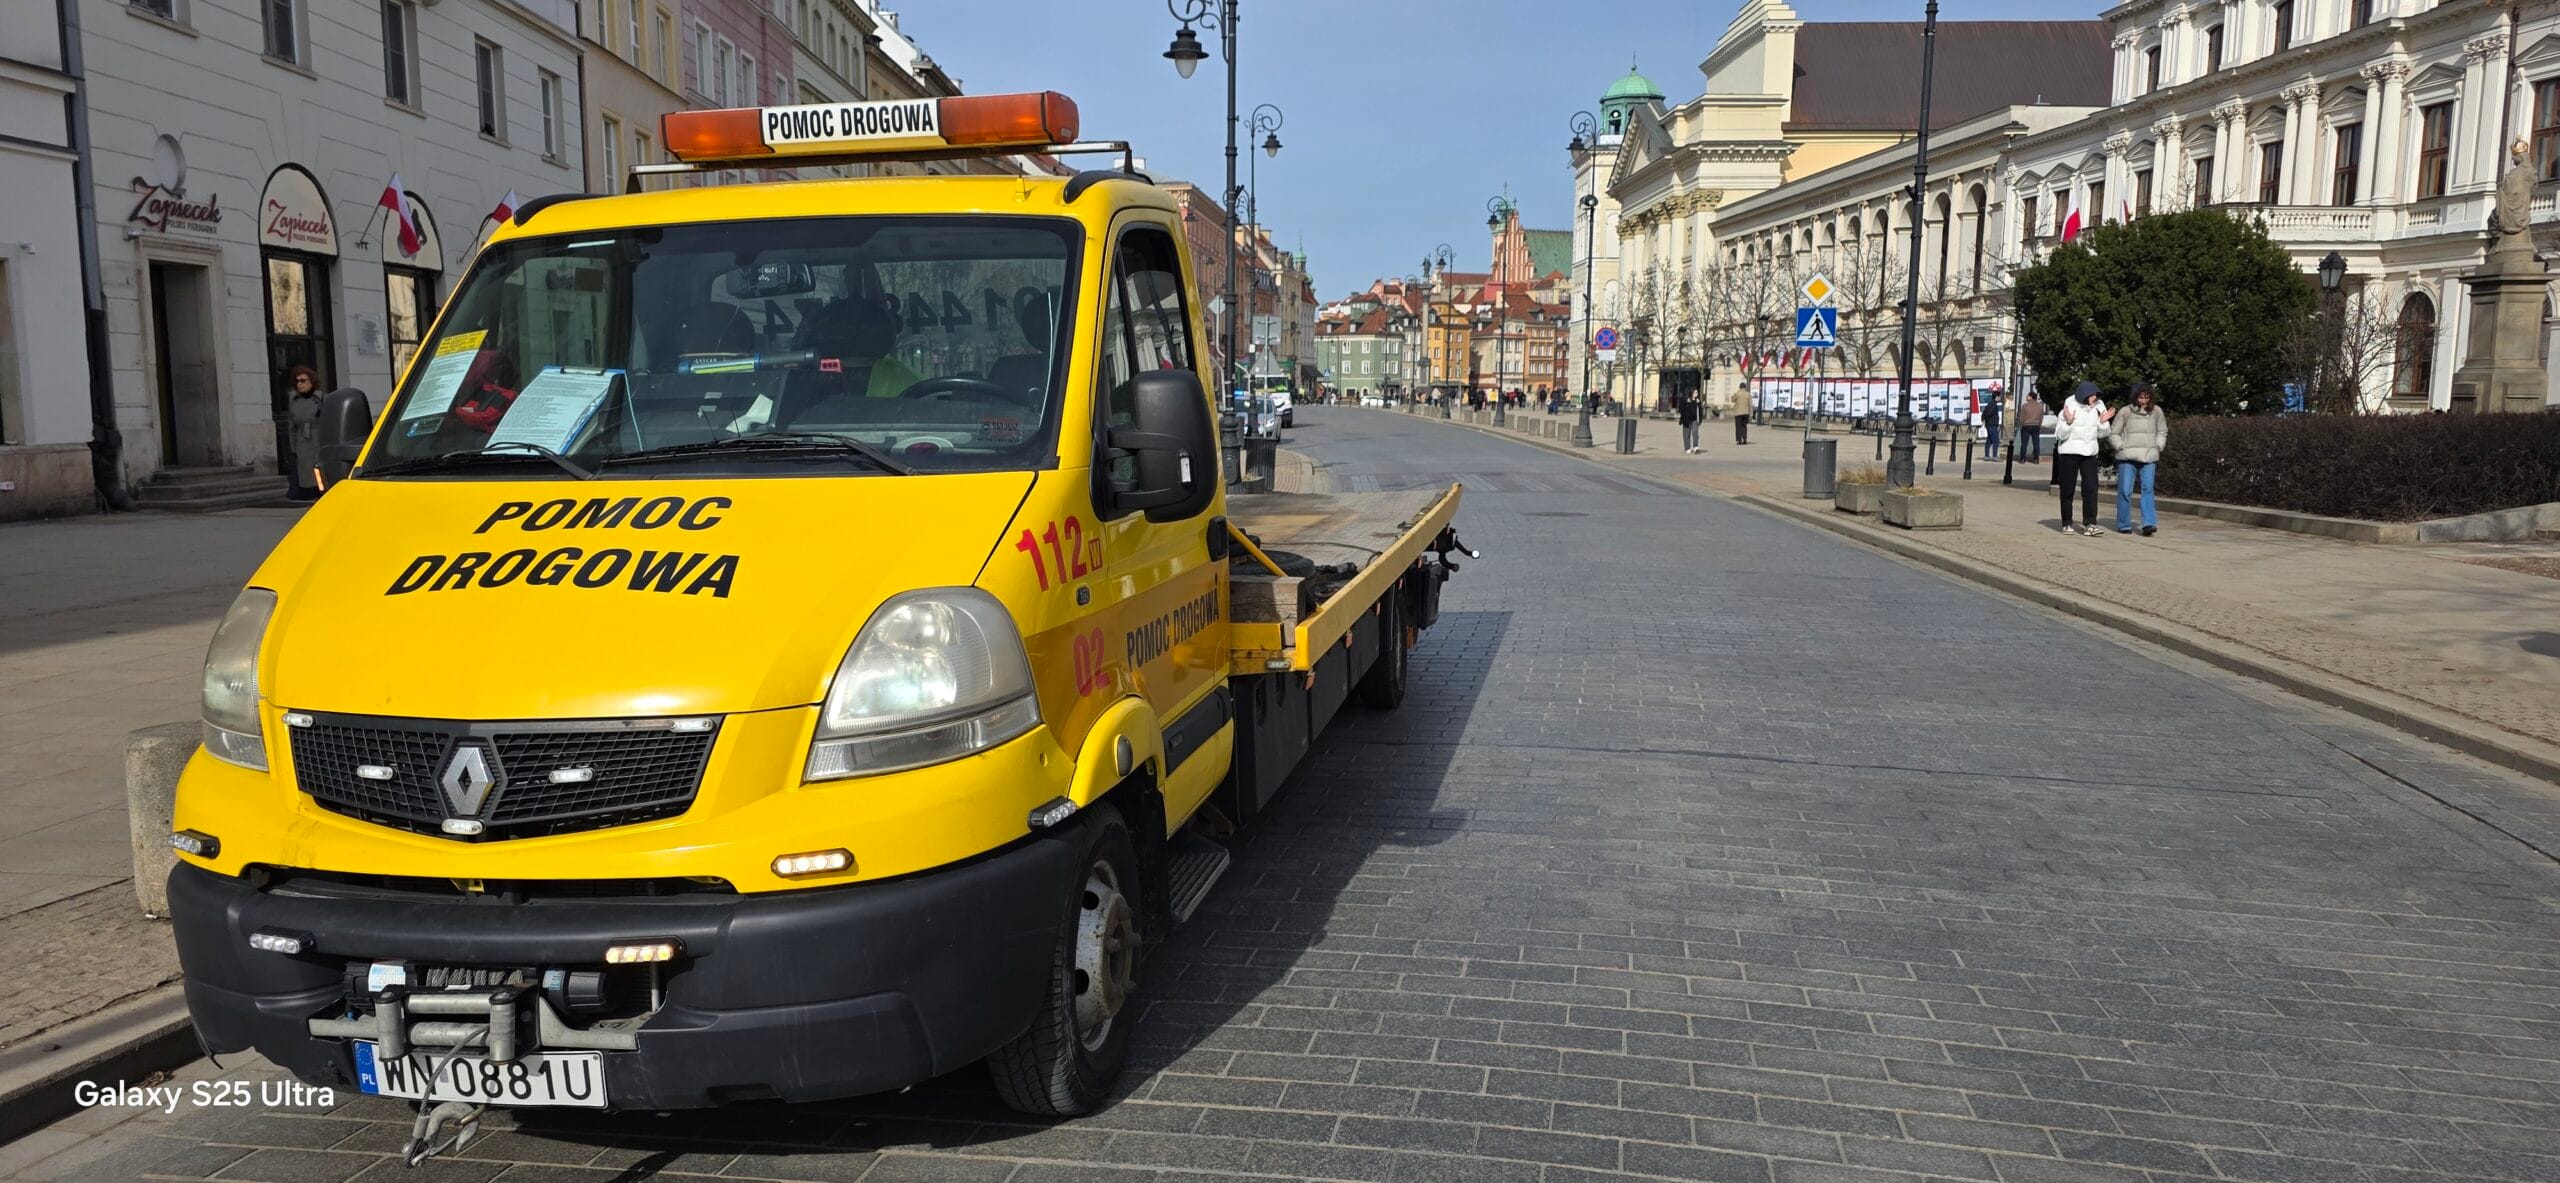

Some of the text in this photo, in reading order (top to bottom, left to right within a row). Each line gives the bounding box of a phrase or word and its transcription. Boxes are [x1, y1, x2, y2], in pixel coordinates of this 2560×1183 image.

[768, 103, 934, 141] POMOC DROGOWA
[128, 176, 223, 234] Zapiecek
[267, 199, 329, 243] Zapiecek
[472, 496, 733, 535] POMOC
[384, 546, 741, 599] DROGOWA
[1015, 516, 1088, 592] 112
[1127, 588, 1220, 672] POMOC DROGOWA
[1073, 626, 1111, 698] 02
[362, 1073, 376, 1086] PL
[383, 1054, 592, 1100] WN 0881U
